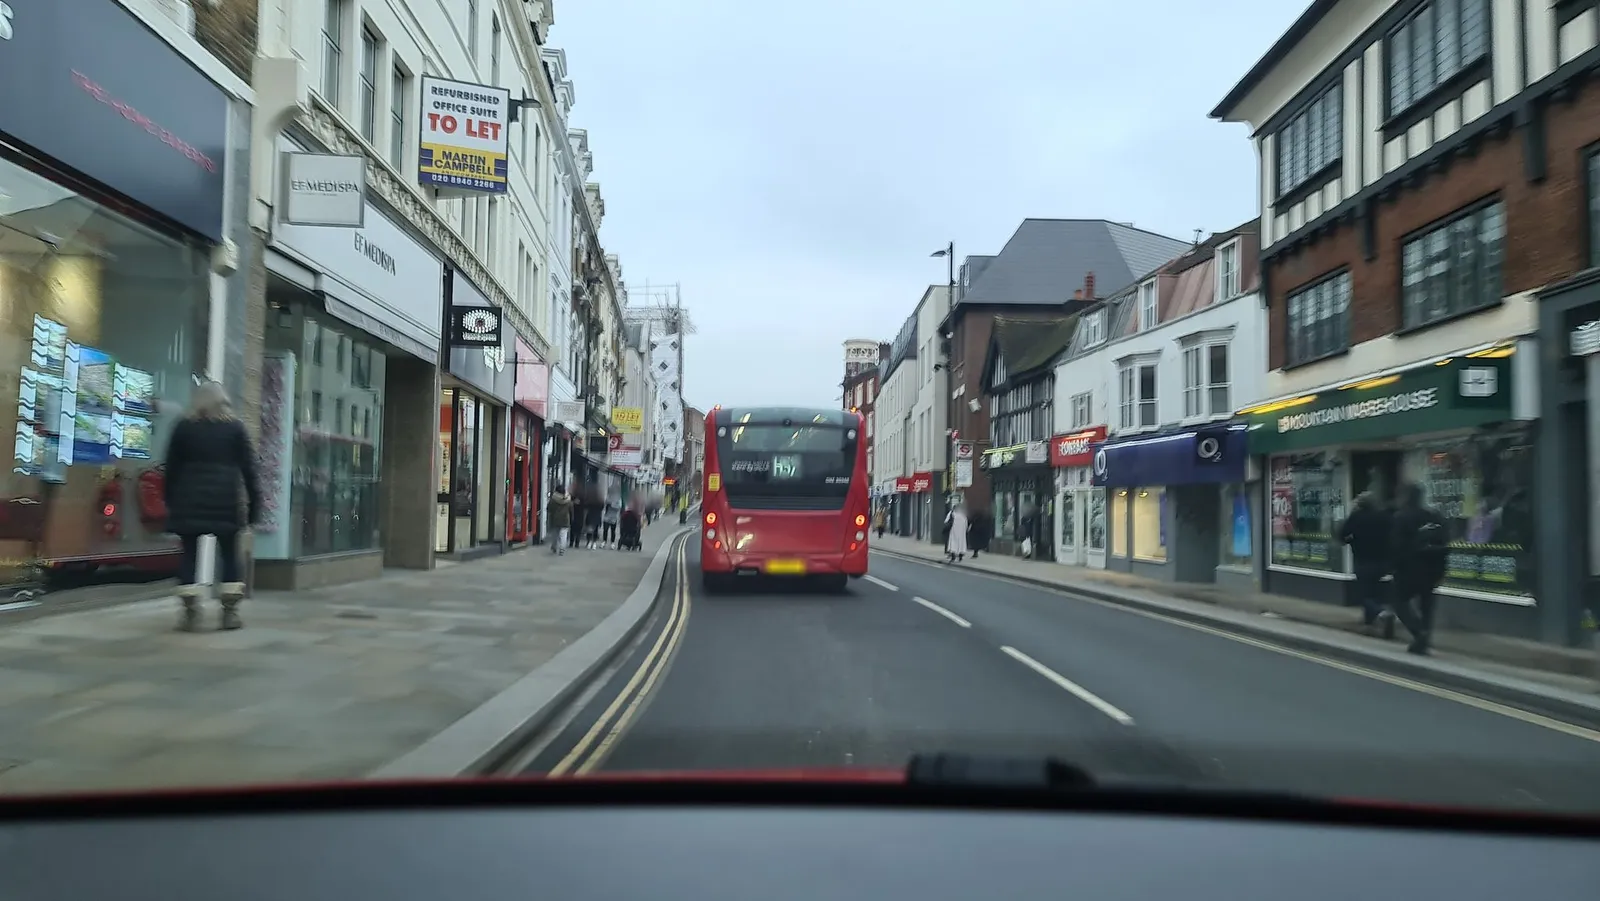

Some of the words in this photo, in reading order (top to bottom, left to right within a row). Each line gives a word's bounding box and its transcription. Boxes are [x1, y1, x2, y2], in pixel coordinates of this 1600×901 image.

[431, 86, 500, 105] REFURBISHED
[433, 101, 467, 113] OFFICE
[470, 107, 498, 119] SUITE
[427, 112, 457, 134] TO
[466, 118, 502, 141] LET
[442, 151, 486, 166] MARTIN
[434, 160, 493, 176] CAMPBELL
[291, 180, 306, 190] EF
[307, 180, 362, 193] MEDISPA
[432, 174, 448, 183] 020
[450, 177, 472, 186] 8940
[354, 231, 364, 253] EF
[364, 237, 396, 276] MEDISPA
[1290, 405, 1346, 431] MOUNTAIN
[1346, 387, 1439, 421] WAREHOUSE
